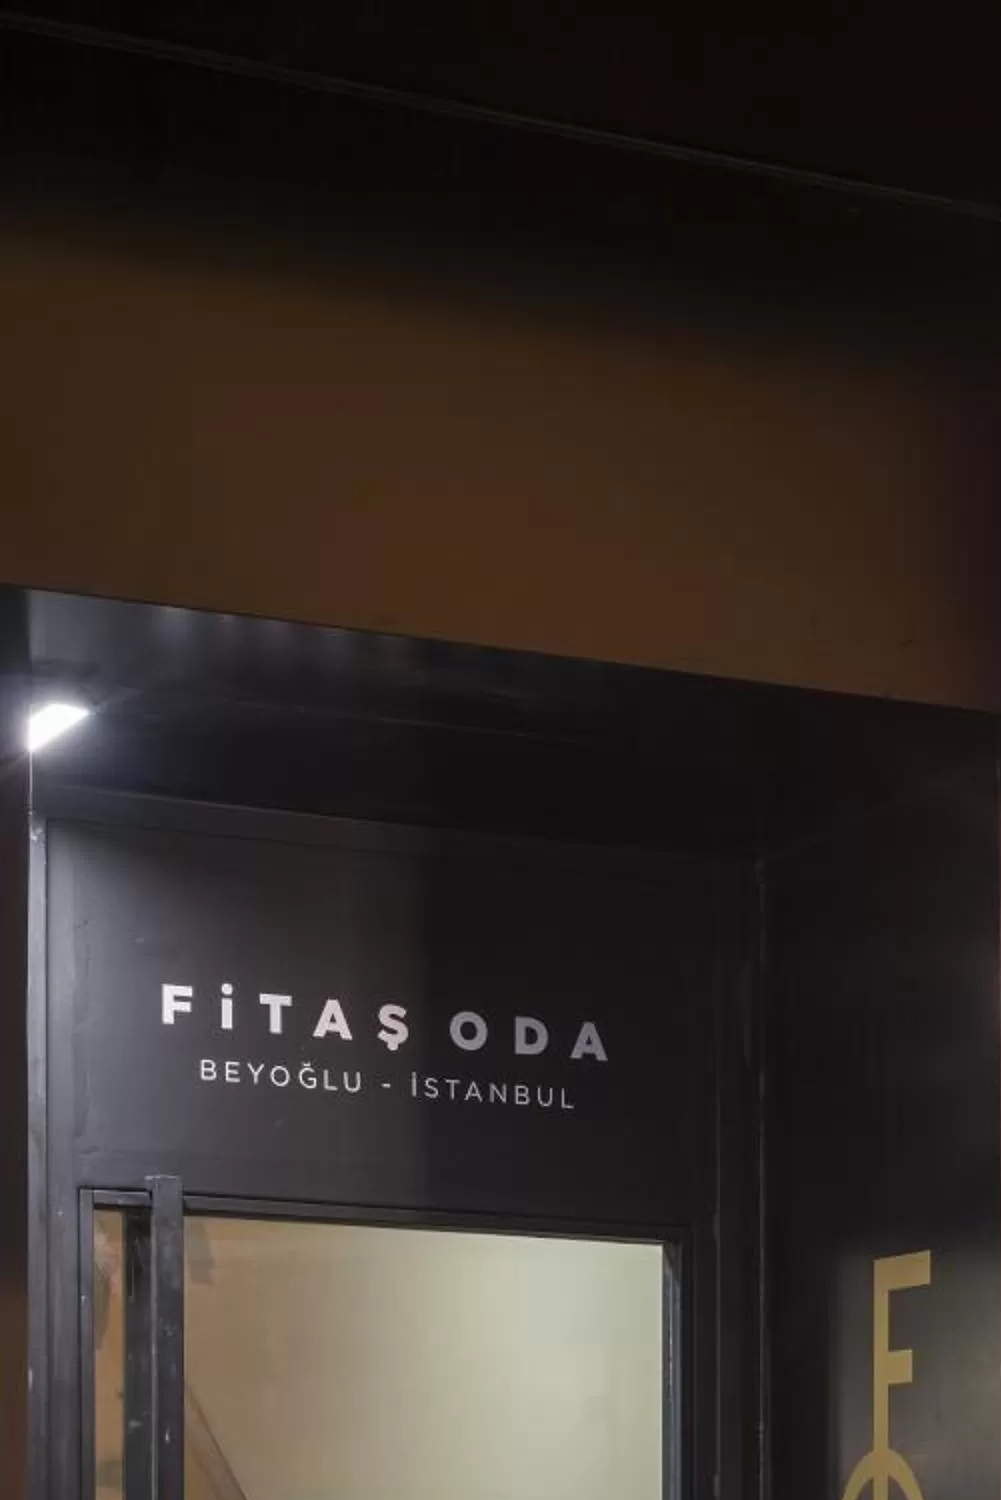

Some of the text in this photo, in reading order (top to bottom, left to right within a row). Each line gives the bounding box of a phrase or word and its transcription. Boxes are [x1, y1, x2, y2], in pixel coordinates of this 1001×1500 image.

[449, 1011, 608, 1061] ODA
[200, 1057, 363, 1093] BEYOĞLU
[411, 1071, 575, 1109] İSTANBUL
